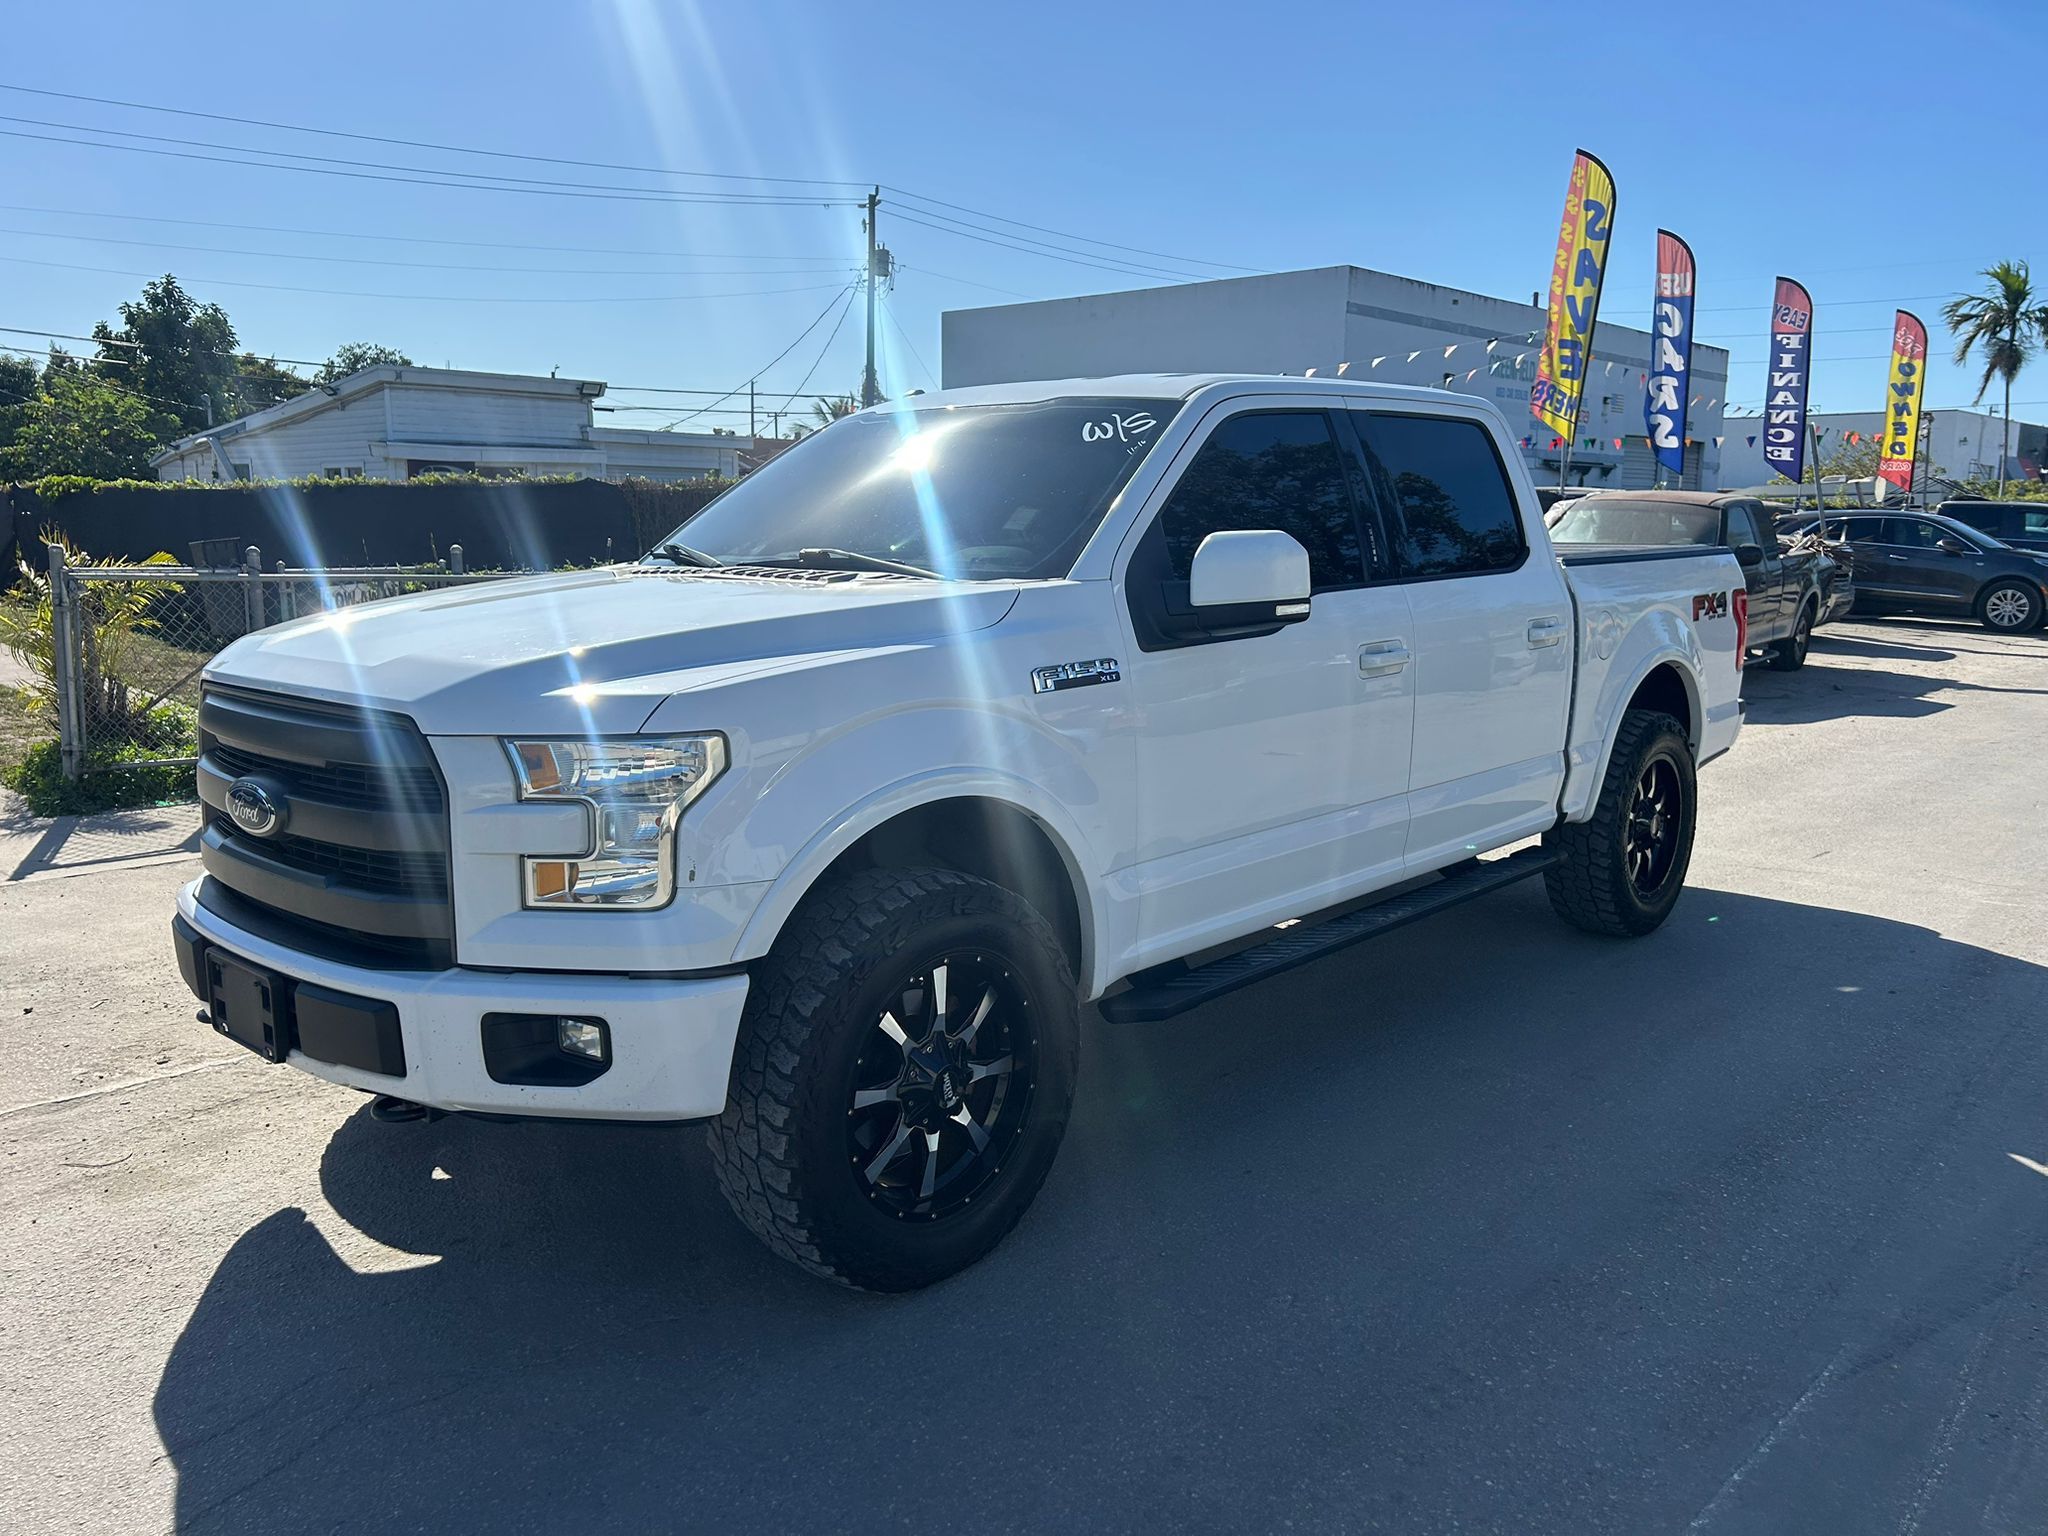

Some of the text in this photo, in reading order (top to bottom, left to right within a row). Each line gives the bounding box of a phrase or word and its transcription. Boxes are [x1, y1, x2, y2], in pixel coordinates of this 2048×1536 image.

[1693, 592, 1727, 621] FX4
[1100, 673, 1117, 682] XLT
[232, 790, 259, 823] Ford
